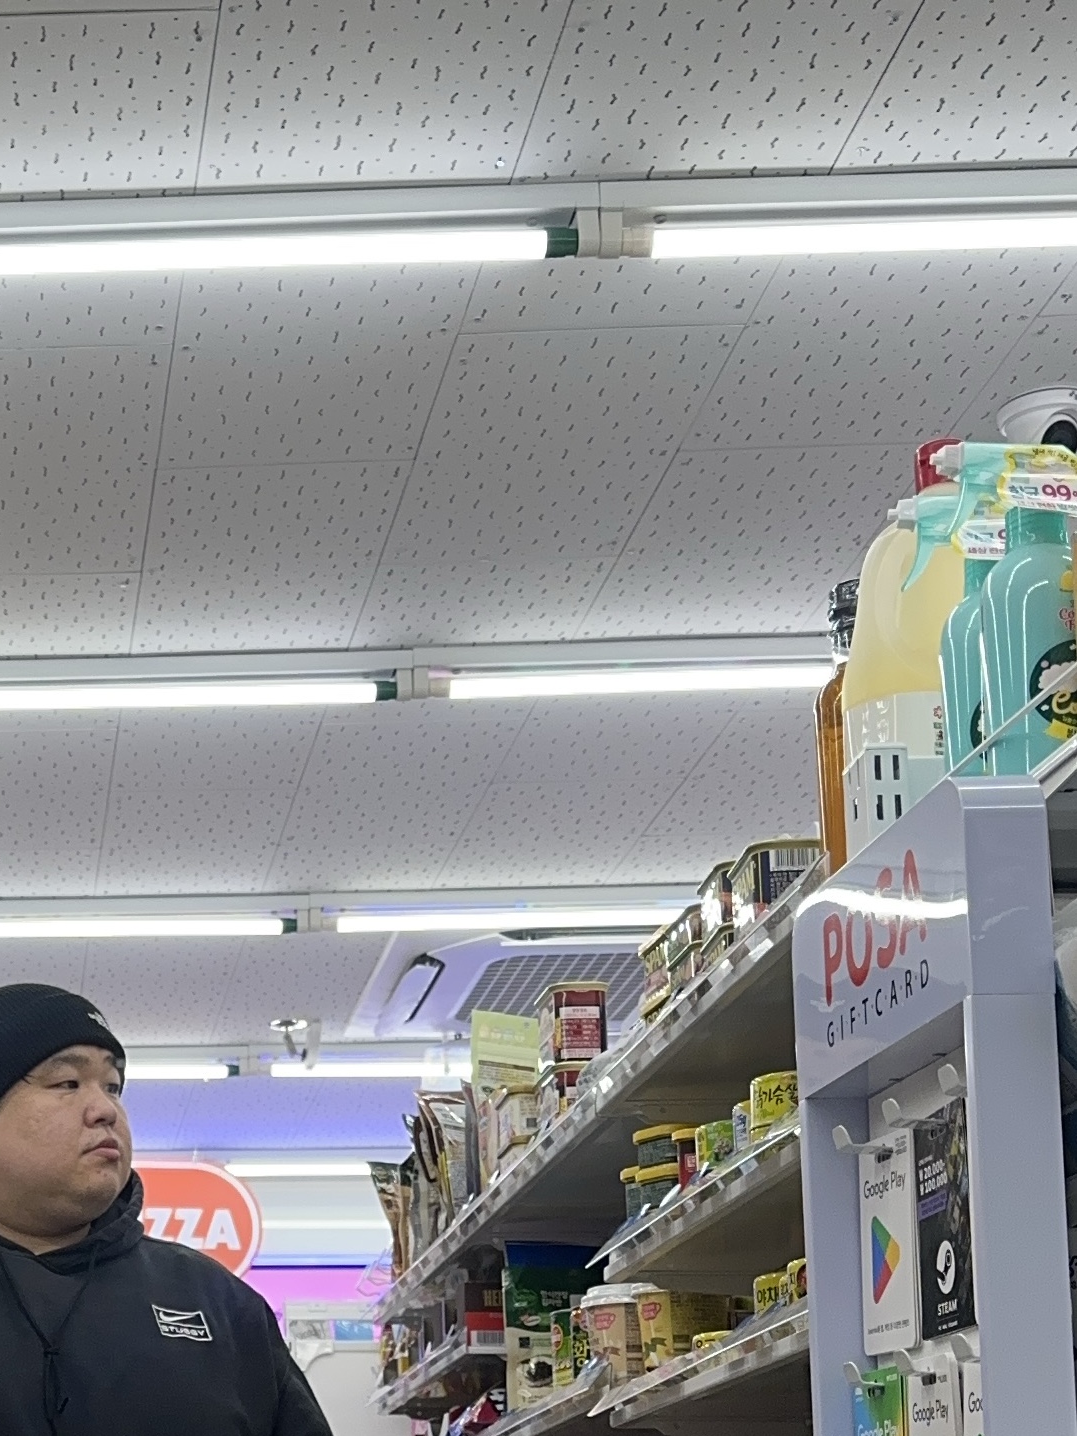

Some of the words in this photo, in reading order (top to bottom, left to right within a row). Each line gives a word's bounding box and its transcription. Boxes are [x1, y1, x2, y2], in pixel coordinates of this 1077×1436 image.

[863, 1177, 890, 1201] Google
[890, 1170, 906, 1192] Play
[937, 1298, 958, 1317] STEAM
[913, 1401, 935, 1427] Google
[936, 1399, 949, 1423] Play
